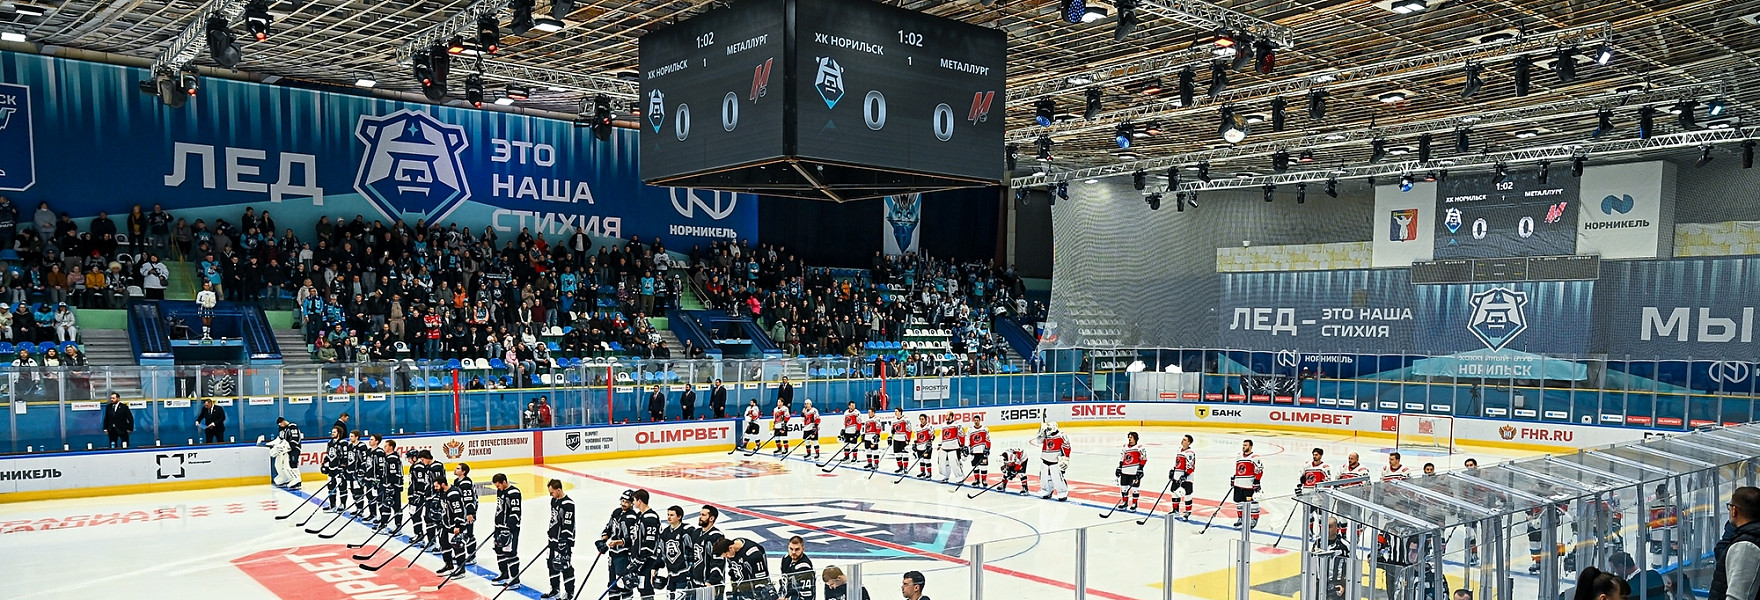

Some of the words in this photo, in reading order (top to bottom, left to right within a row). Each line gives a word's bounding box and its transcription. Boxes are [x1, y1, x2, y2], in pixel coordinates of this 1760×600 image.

[696, 31, 714, 48] 1:02
[726, 34, 769, 56] МЕТАЛЛУРГ
[815, 32, 828, 45] ХК
[831, 36, 884, 56] НОРИЛЬСК
[898, 30, 923, 47] 1:02
[702, 58, 707, 67] 1
[908, 56, 912, 66] 1
[940, 58, 990, 77] МЕТАЛЛУРГ
[647, 70, 655, 80] ХК
[656, 59, 688, 78] НОРИЛЬСК
[722, 91, 738, 132] 0
[863, 90, 887, 131] 0
[675, 103, 691, 141] 0
[933, 102, 954, 142] 0
[491, 138, 556, 167] ЭТО
[164, 142, 324, 206] ЛЕД
[492, 173, 595, 205] НАША
[1496, 182, 1513, 191] 1:02
[1524, 188, 1563, 197] МЕТАЛЛУРГ
[492, 209, 622, 239] СТИХИЯ
[669, 224, 738, 239] НОРНИКЕЛЬ
[1472, 218, 1487, 240] 0
[1518, 216, 1534, 239] 0
[1585, 219, 1650, 230] НОРНИКЕЛЬ
[1229, 308, 1298, 336] ЛЕД
[1321, 308, 1354, 320] ЭТО
[1360, 308, 1413, 321] НАША
[1640, 306, 1754, 343] МЫ
[1321, 325, 1390, 338] СТИХИЯ
[1304, 355, 1353, 364] НОРНИКЛЬ
[1459, 364, 1532, 376] НОРИЛЬСК
[1071, 405, 1126, 416] SINTEC
[1212, 409, 1242, 417] БАНК
[1269, 411, 1353, 425] OLIMPBET
[468, 440, 479, 448] ЛЕТ
[480, 437, 529, 447] ОТЕЧЕСТВЕННОМУ
[635, 427, 729, 445] OLIMPBET
[1521, 428, 1573, 442] FHR.RU
[468, 447, 491, 456] ХОККЕЮ
[0, 468, 62, 481] НИКЕЛЬ
[463, 489, 472, 497] 23
[646, 526, 656, 535] 22
[756, 561, 764, 571] 11
[800, 579, 811, 590] 74
